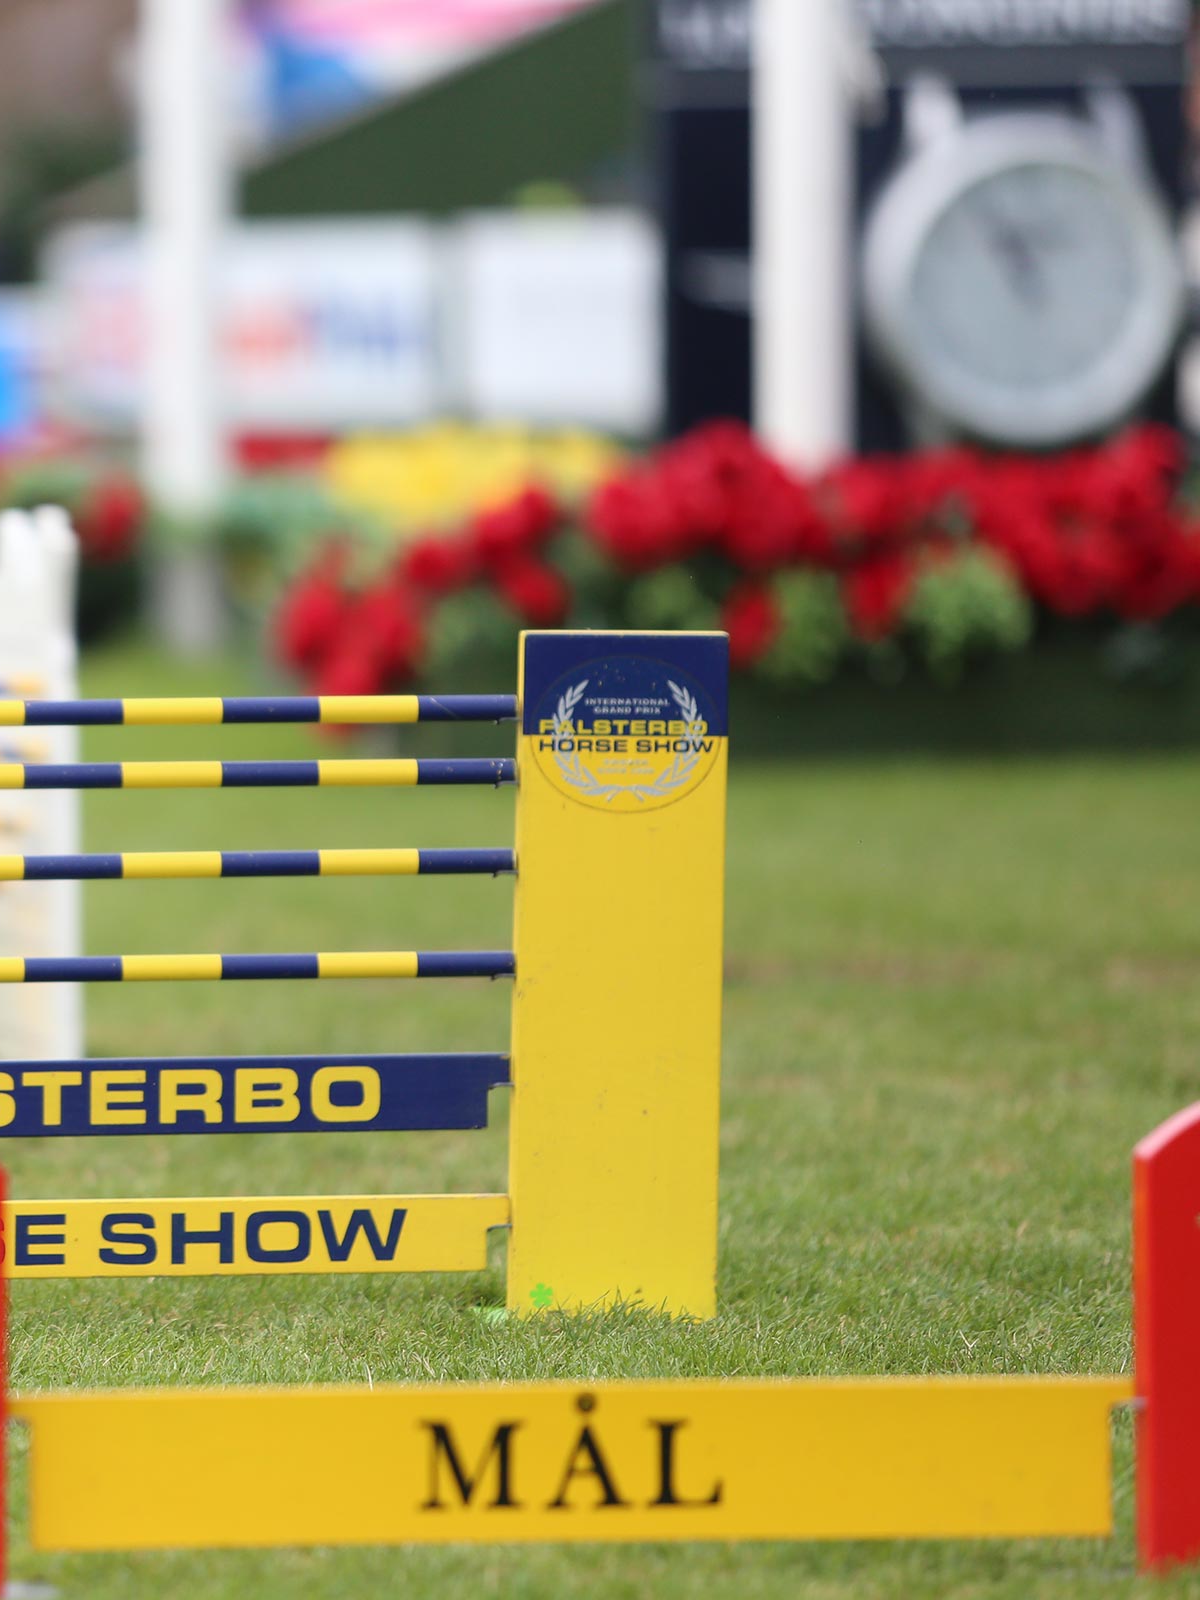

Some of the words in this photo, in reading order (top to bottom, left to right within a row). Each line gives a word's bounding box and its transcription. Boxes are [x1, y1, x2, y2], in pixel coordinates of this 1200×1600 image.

[585, 698, 670, 706] INTERNATIONAL
[593, 706, 632, 714] GRAND
[635, 706, 661, 714] PRIX
[539, 719, 708, 735] FALSTERBO
[539, 739, 628, 752] HORSE
[636, 739, 713, 752] SHOW
[98, 1208, 408, 1266] SHOW
[417, 1392, 725, 1511] MÅL
